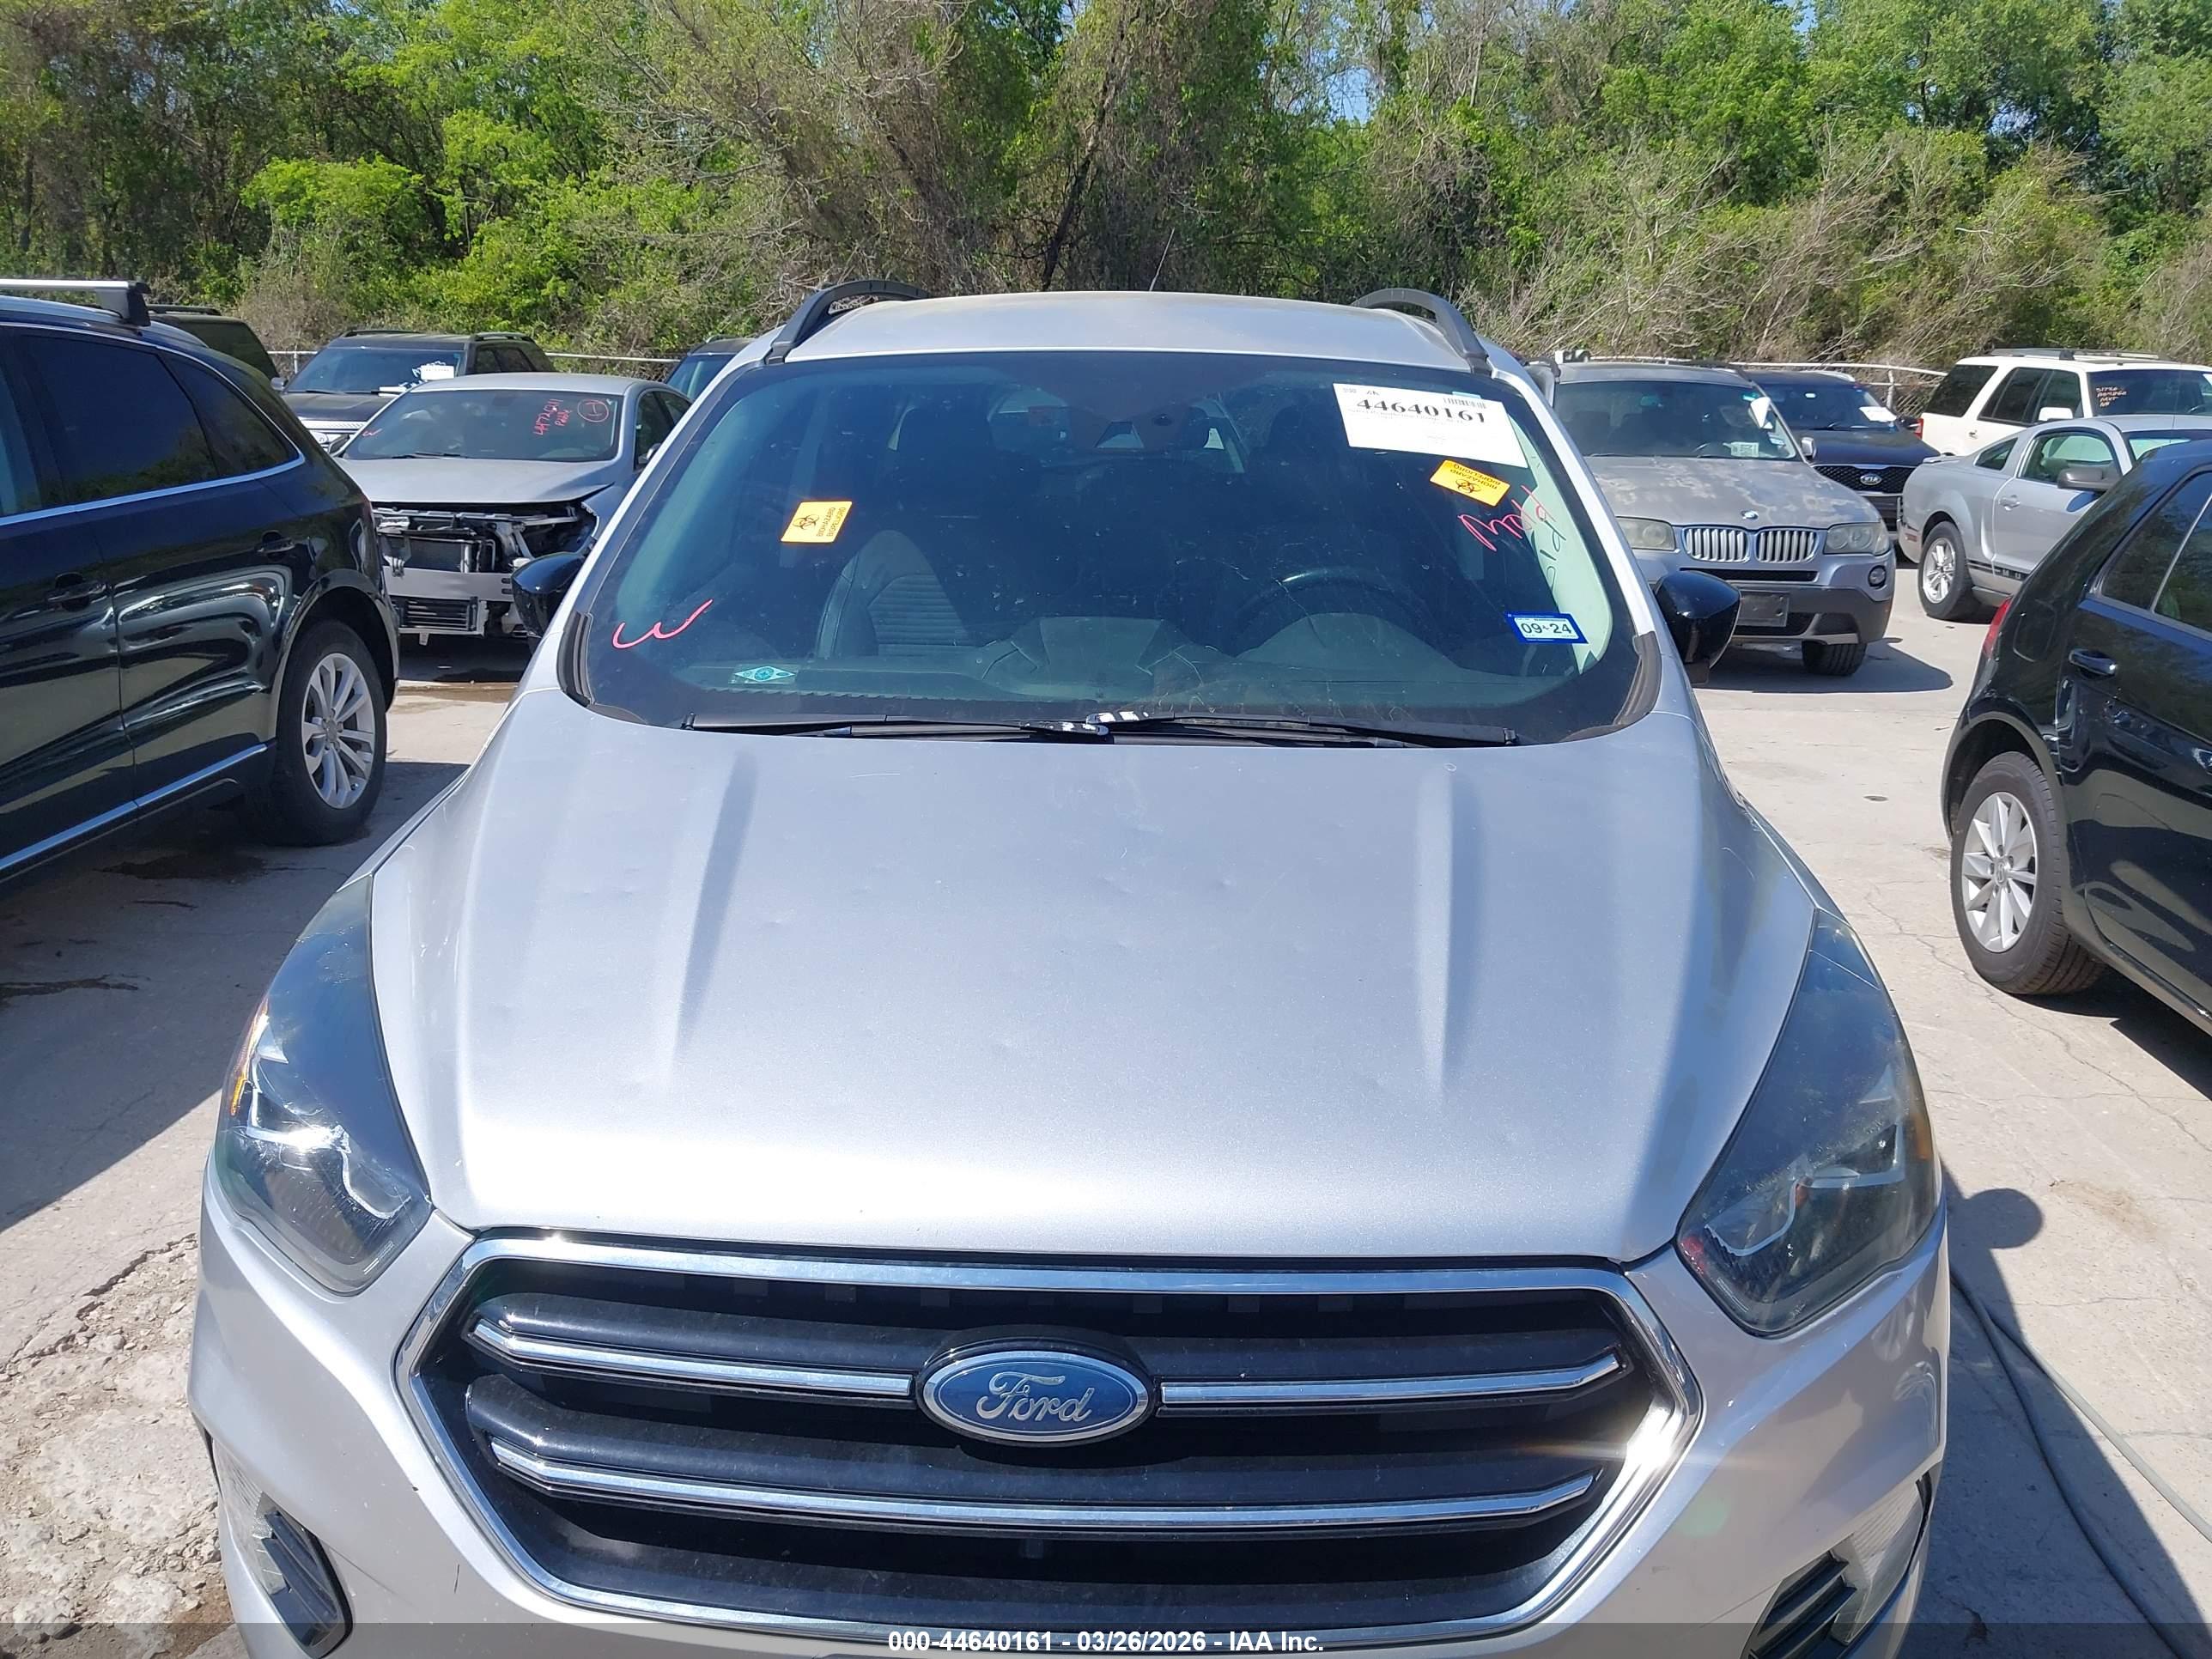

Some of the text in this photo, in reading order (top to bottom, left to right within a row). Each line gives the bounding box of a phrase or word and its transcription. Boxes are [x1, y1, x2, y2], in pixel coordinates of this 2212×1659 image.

[1357, 398, 1485, 423] 44640161
[1449, 469, 1498, 489] BIOHAZARD
[975, 1371, 1095, 1422] Ford
